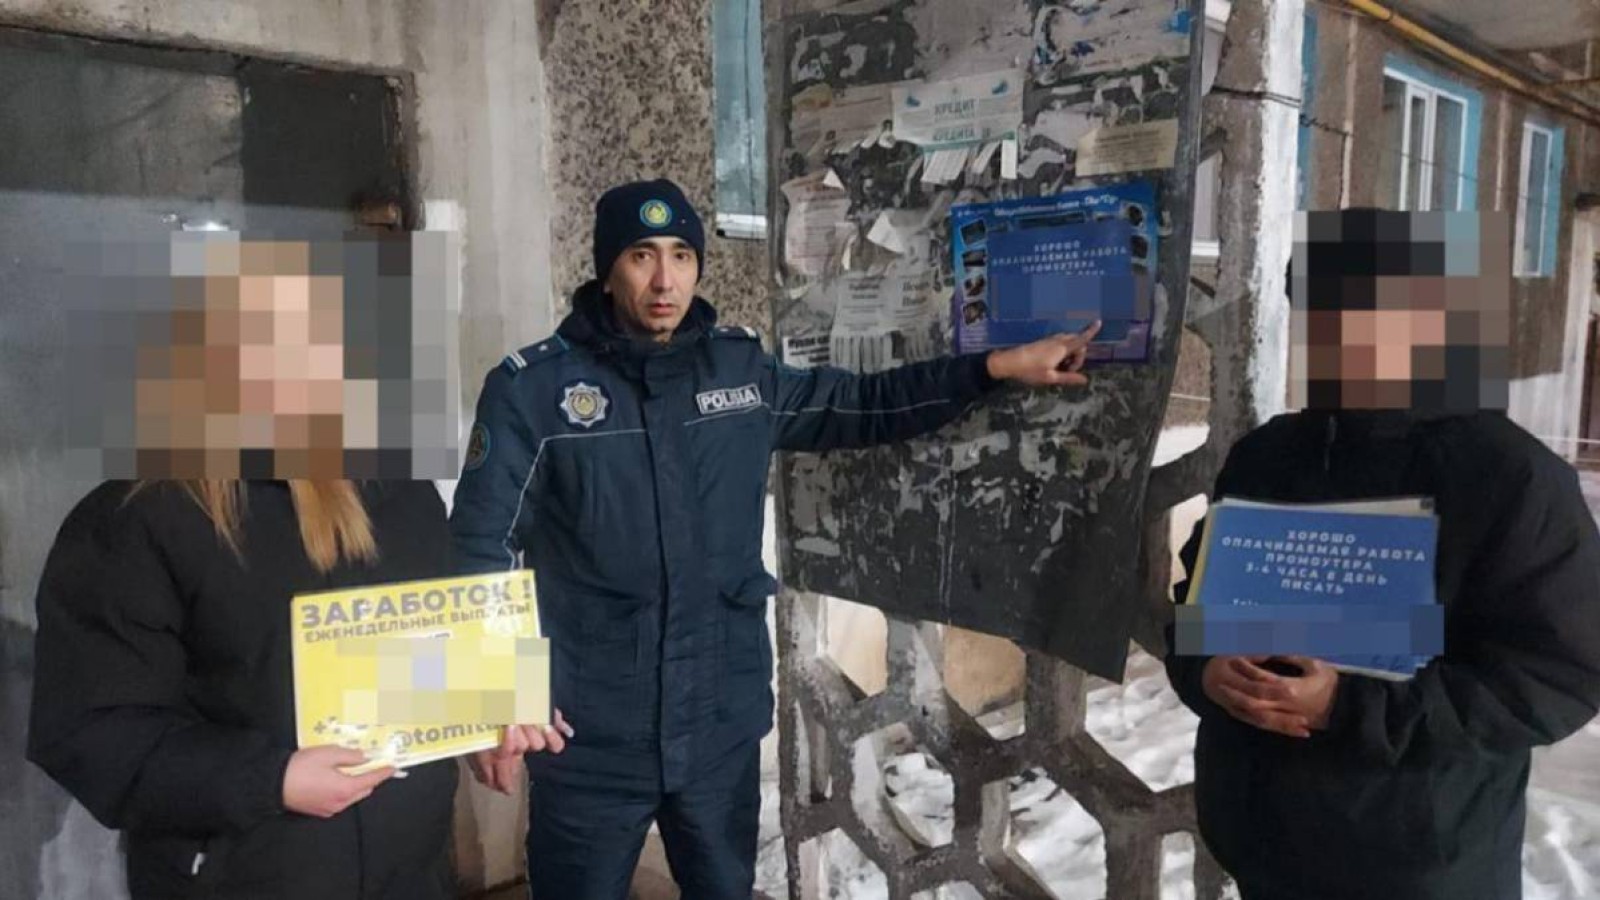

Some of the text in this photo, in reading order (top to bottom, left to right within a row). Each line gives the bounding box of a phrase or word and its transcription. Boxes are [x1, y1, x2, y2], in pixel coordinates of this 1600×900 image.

[1287, 530, 1356, 545] ХОРОШО
[1221, 536, 1425, 562] ОПЛАЧИВАЕМАЯ РАБОТА
[1265, 553, 1373, 571] ПРОМОУТЕРА
[1277, 566, 1318, 579] ЧАСА
[1343, 572, 1388, 586] ДЕНЬ
[1281, 578, 1344, 595] ПИСАТЬ
[301, 581, 512, 629] ЗАРАБОТОК
[304, 603, 530, 643] ЕЖЕНЕДЕЛЬНЫЕ ВЫПАТЫ
